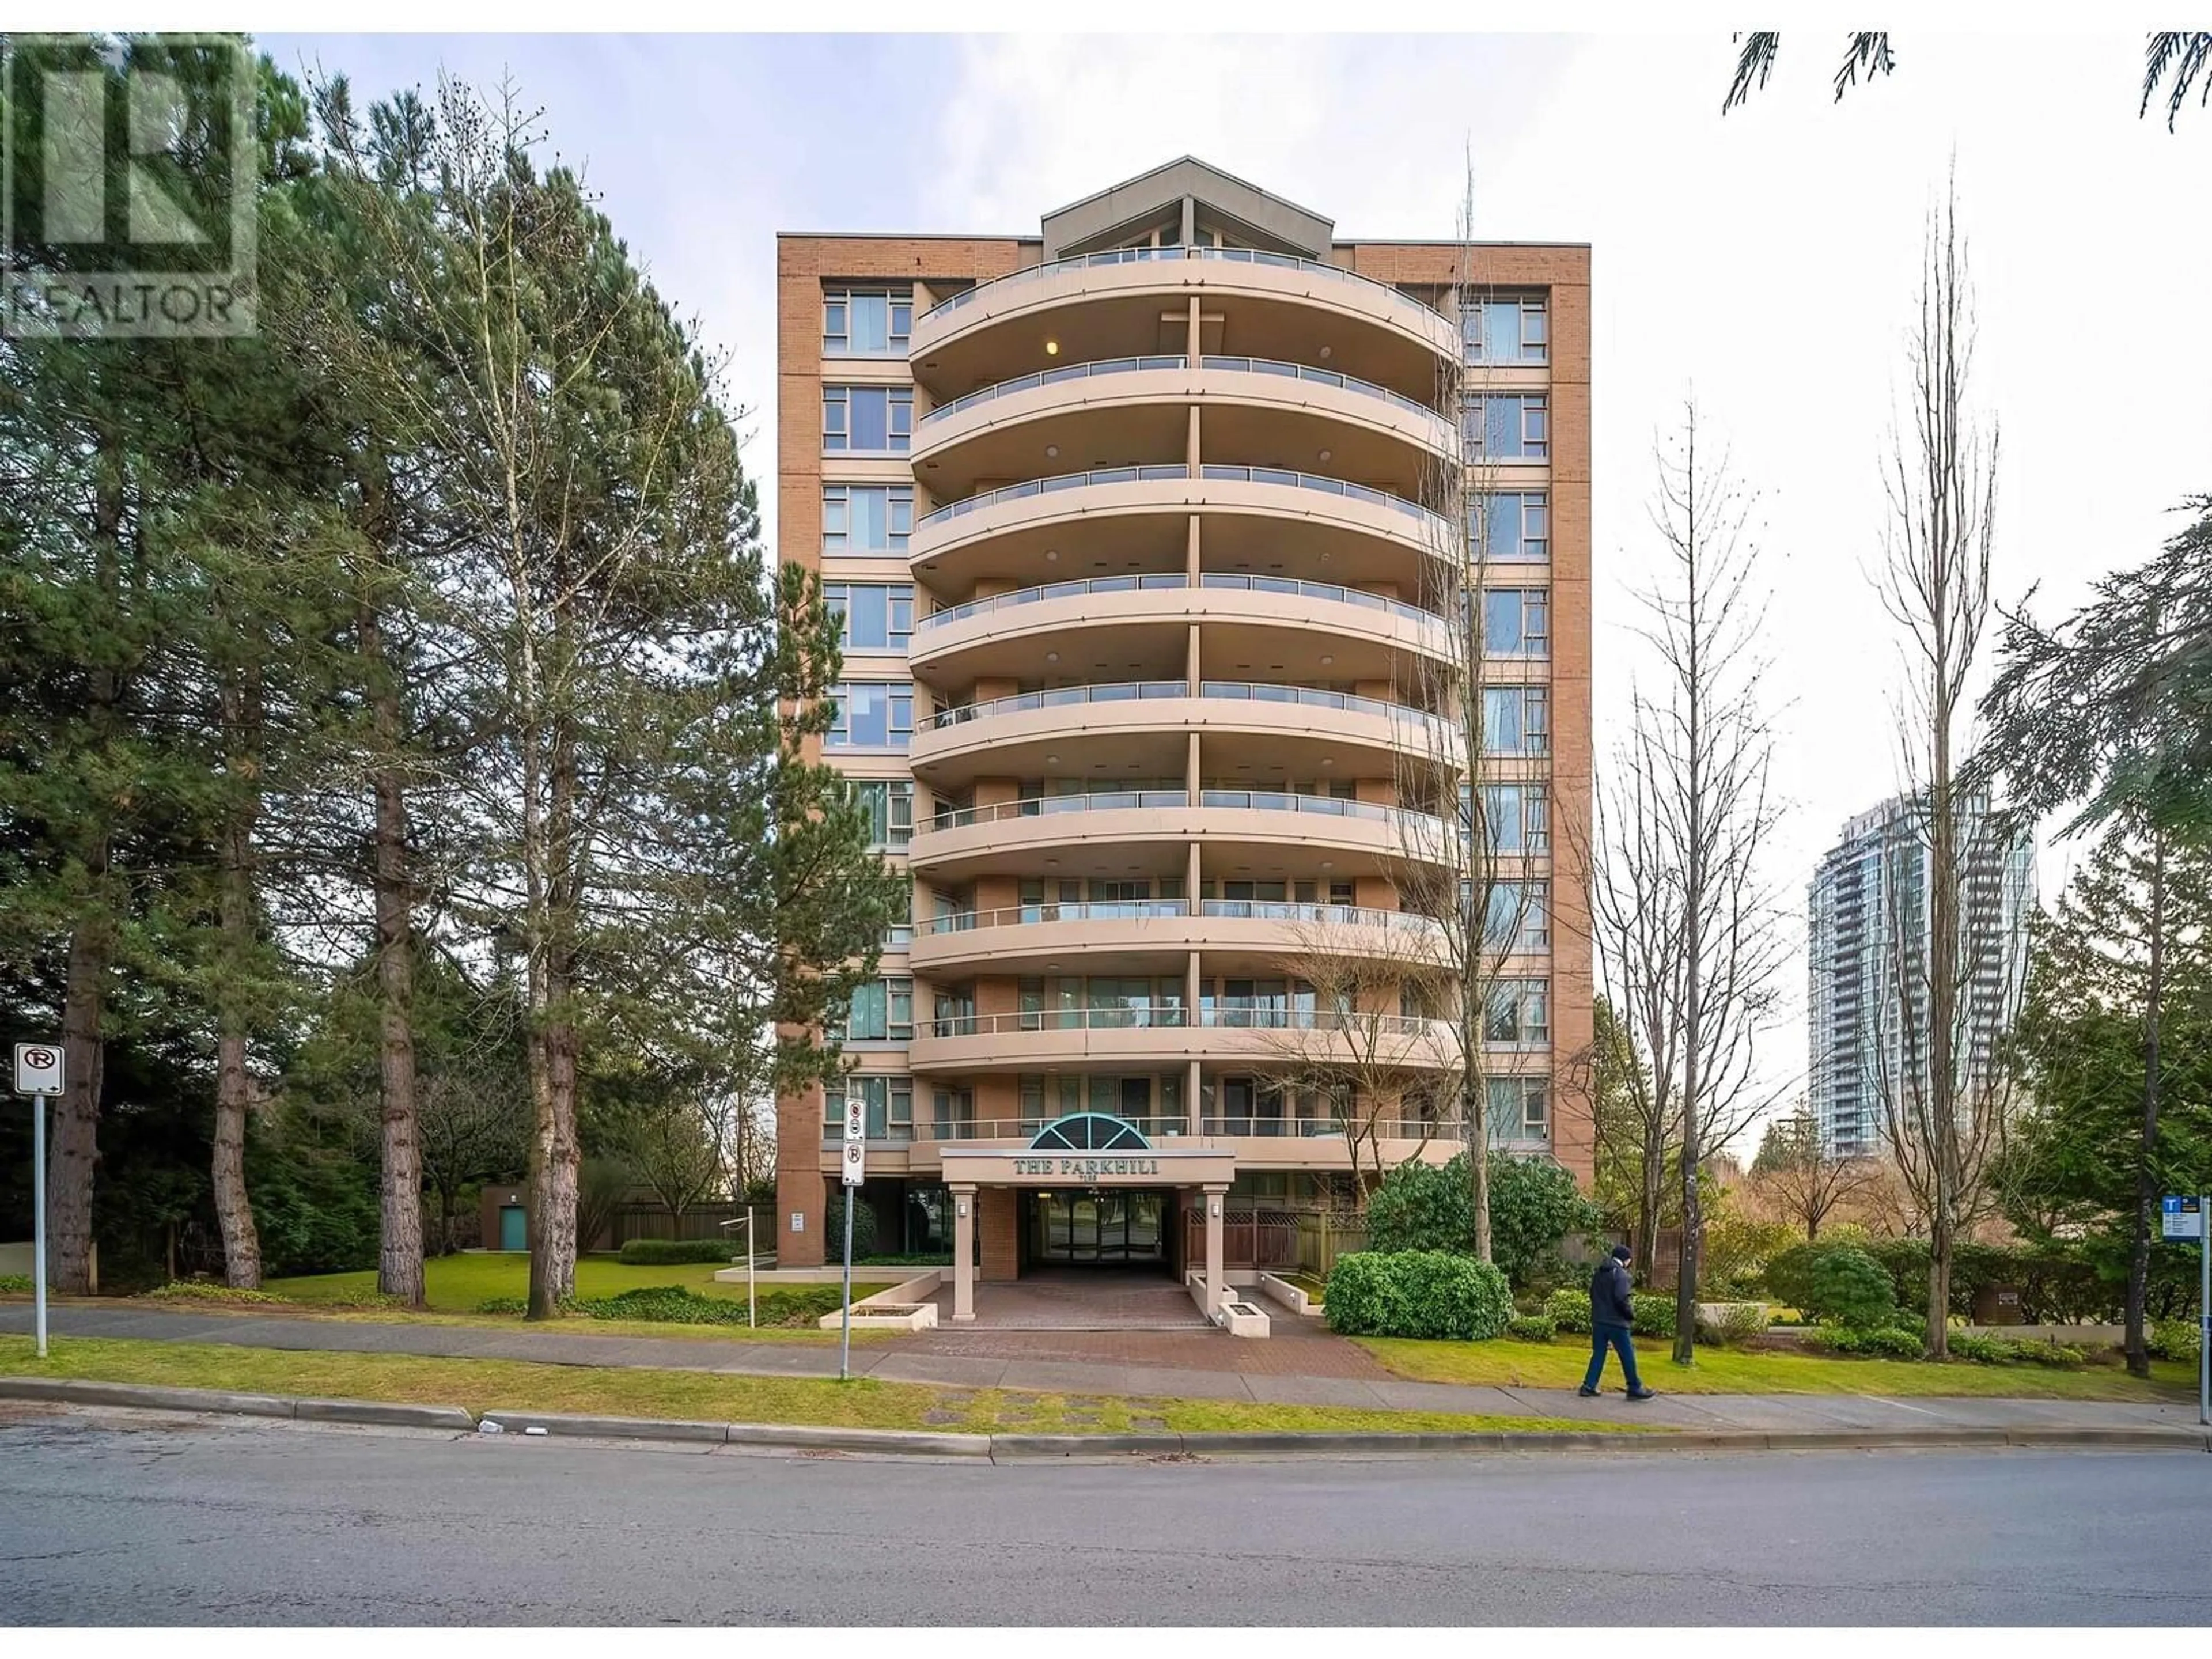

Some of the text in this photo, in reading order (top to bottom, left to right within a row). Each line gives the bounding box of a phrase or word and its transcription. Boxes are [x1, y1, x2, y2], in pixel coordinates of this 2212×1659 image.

[1013, 1160, 1159, 1174] THE PARKHILL
[2166, 1199, 2176, 1210] T
